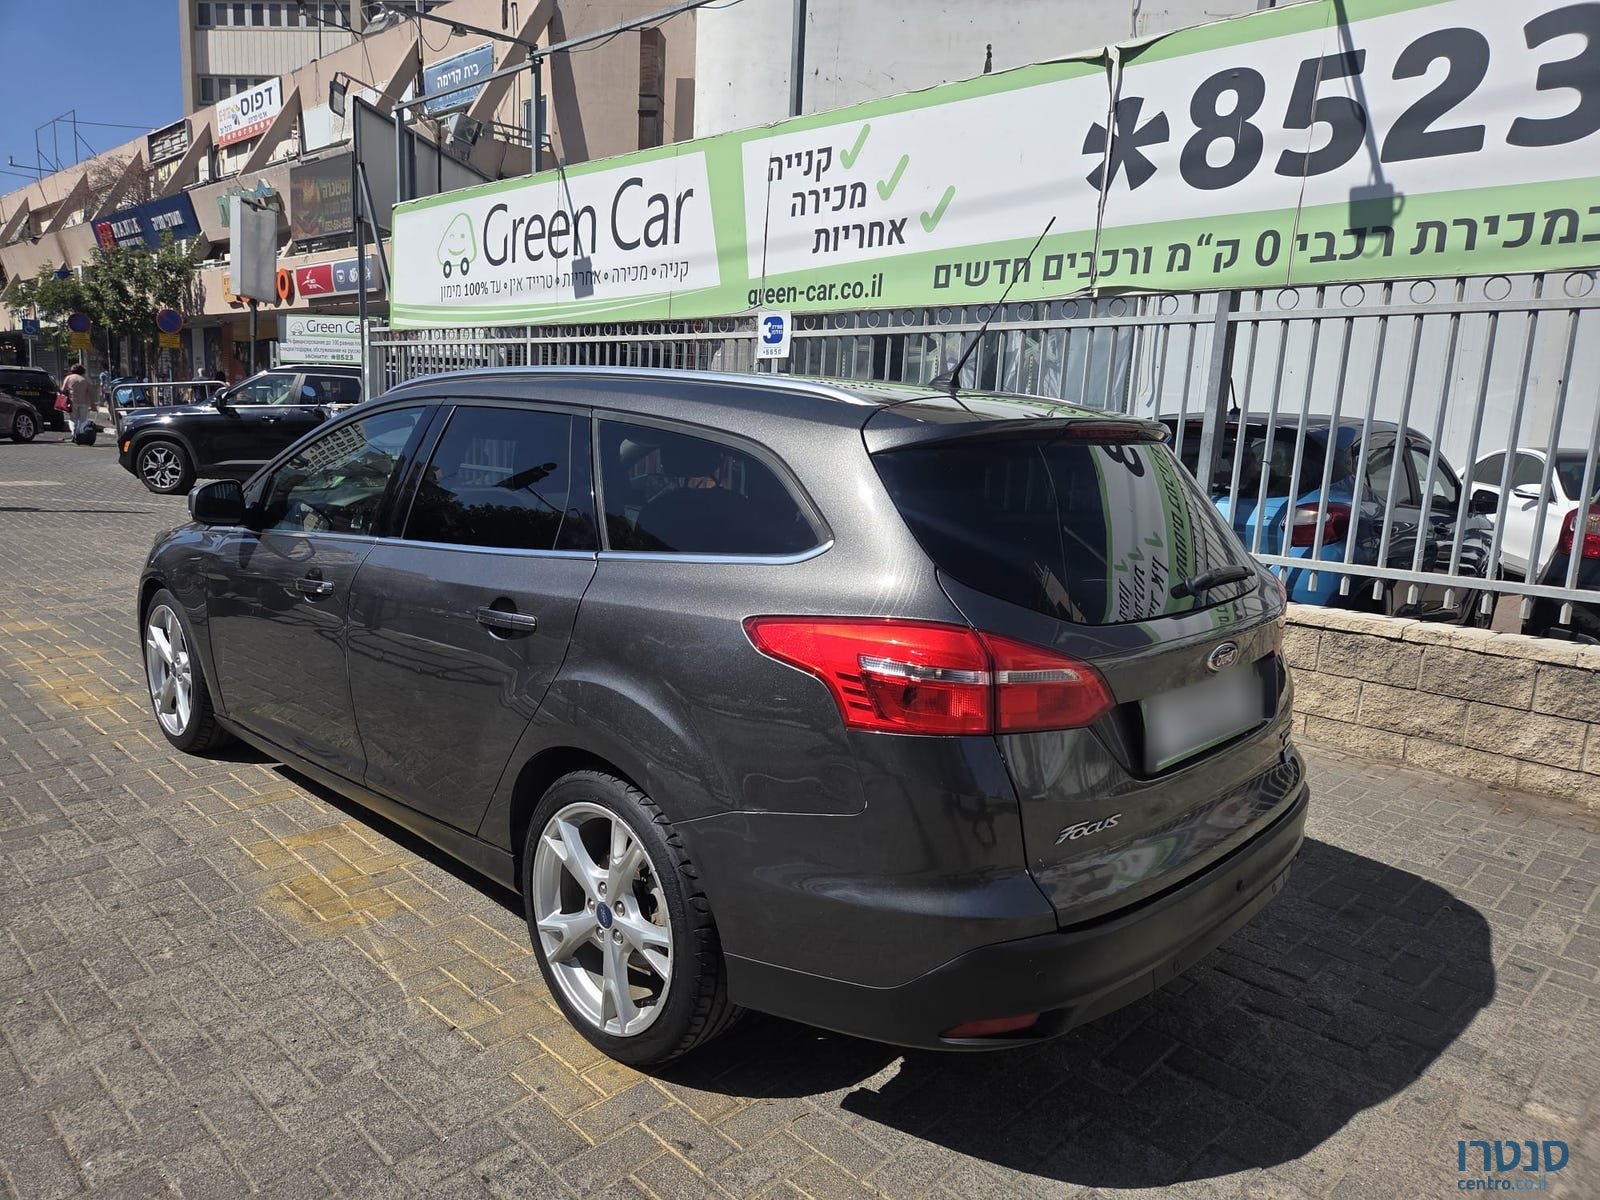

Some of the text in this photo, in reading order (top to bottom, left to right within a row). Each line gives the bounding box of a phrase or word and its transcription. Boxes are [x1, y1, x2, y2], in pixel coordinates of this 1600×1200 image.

[240, 86, 273, 116] דפוס
[768, 146, 834, 183] קנייה
[790, 180, 867, 217] מכירה
[483, 177, 694, 267] Green Car
[812, 216, 908, 254] אחריות
[1255, 229, 1282, 268] 0
[1295, 225, 1395, 264] רכבי
[440, 261, 689, 303] קניה מכירה אחריות טרייד אין עד 100% מימון
[932, 256, 1033, 290] חדשים
[1042, 245, 1153, 282] ורכבים
[747, 272, 884, 309] green-car.co.il
[306, 319, 361, 334] Green Ca
